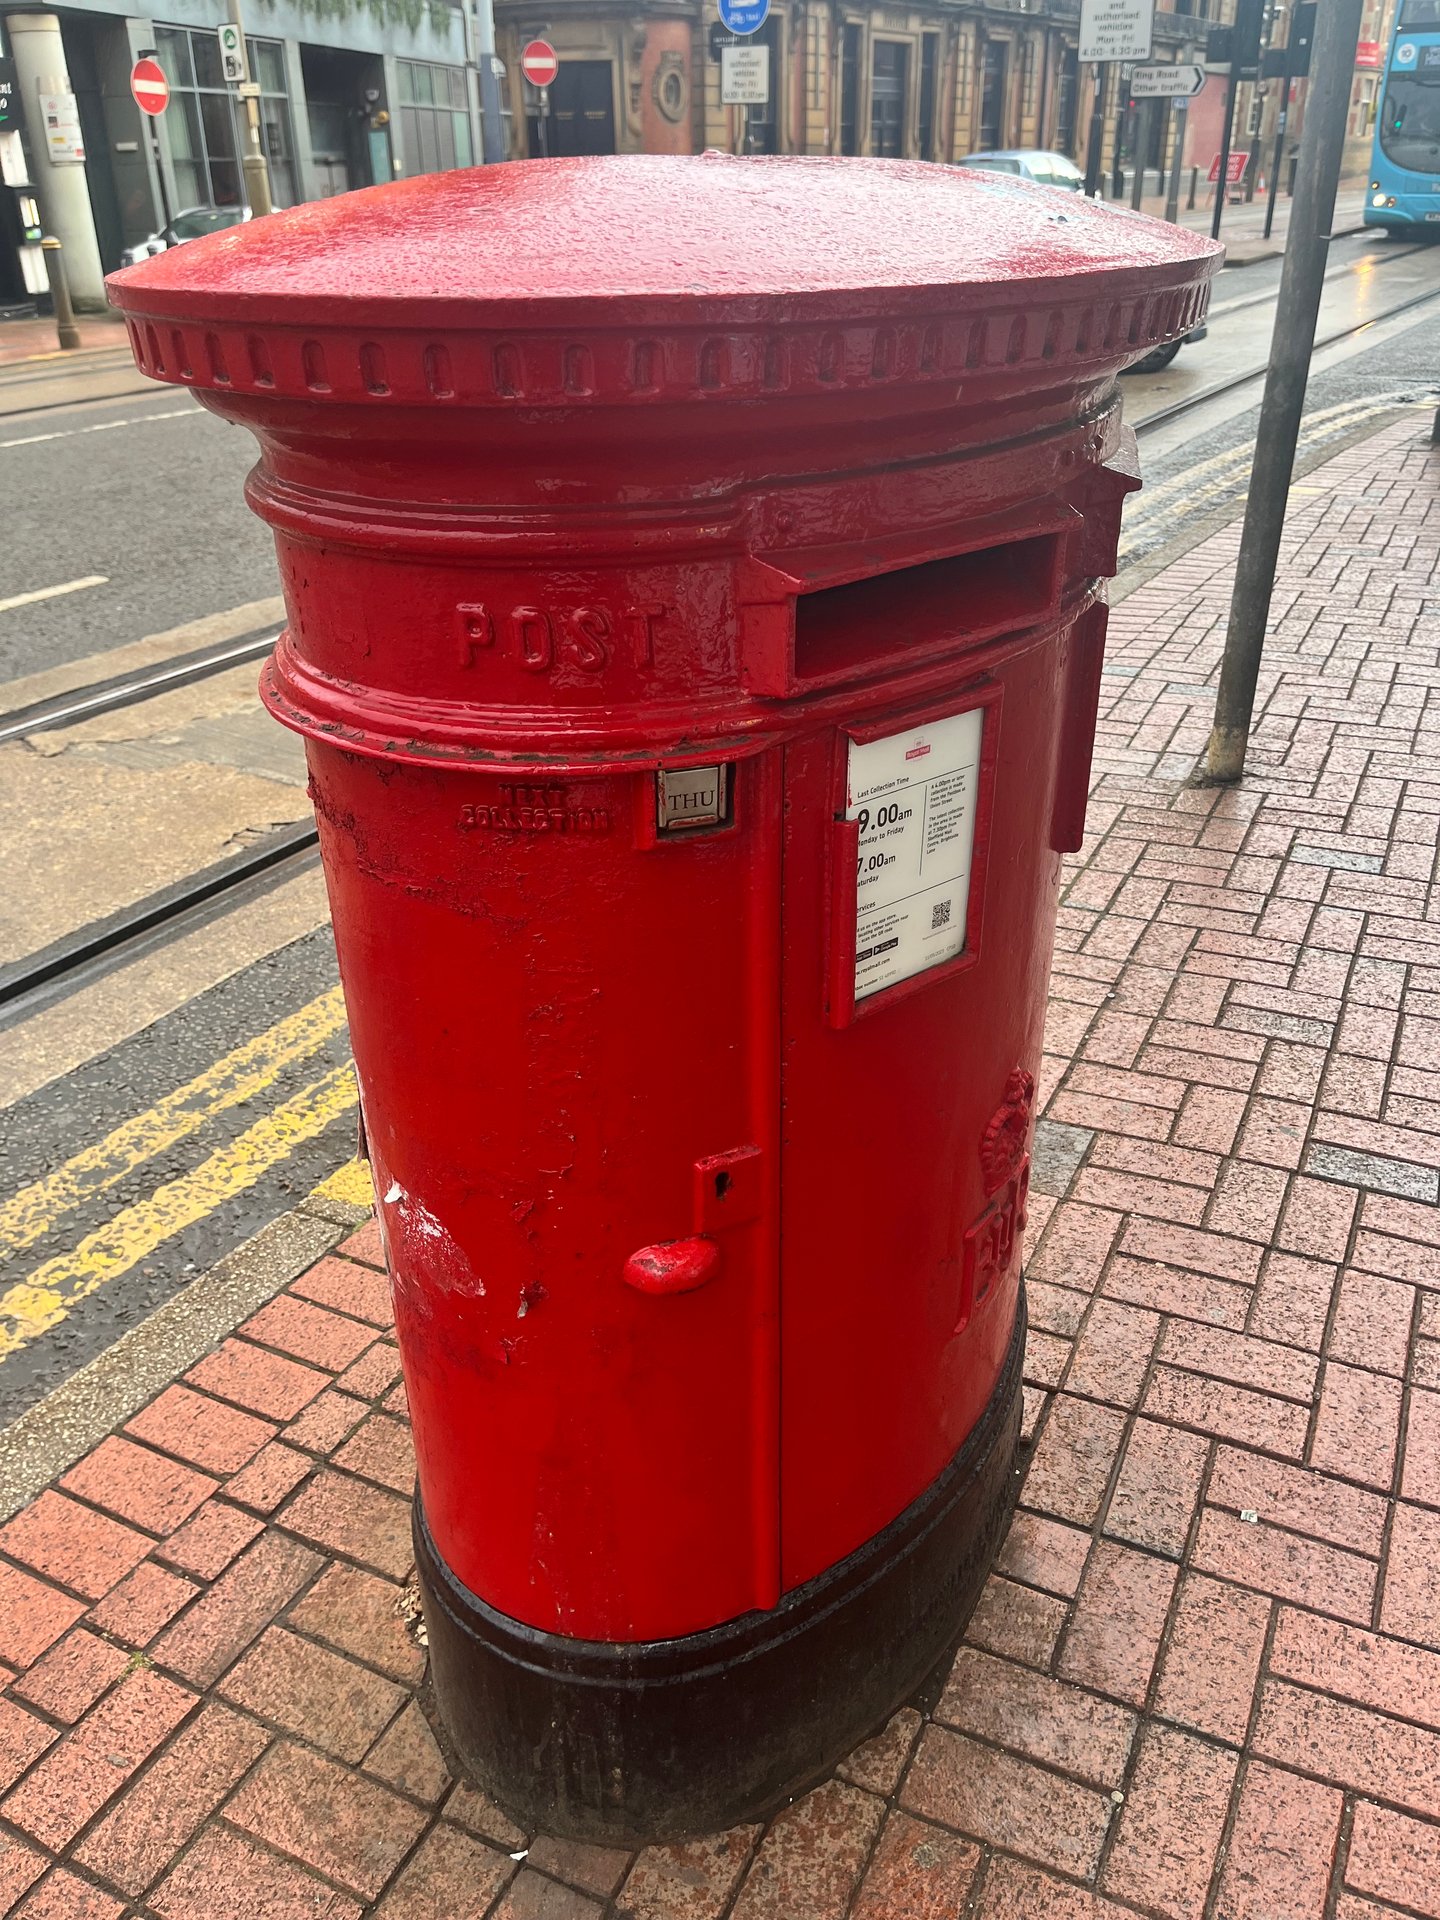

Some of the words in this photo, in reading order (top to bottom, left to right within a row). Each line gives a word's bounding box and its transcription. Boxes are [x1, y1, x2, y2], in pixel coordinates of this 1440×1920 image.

[1135, 71, 1153, 81] Ring
[1157, 70, 1179, 79] Road
[1133, 83, 1157, 92] Other
[1160, 82, 1189, 92] traffic
[456, 602, 663, 671] POST
[857, 789, 869, 799] Last
[870, 781, 896, 795] Collection
[896, 777, 910, 785] Time
[667, 791, 716, 811] THU
[459, 803, 611, 831] COLLECTION
[857, 803, 913, 834] 9.00am
[887, 826, 905, 837] Friday
[857, 875, 880, 888] aturday
[857, 901, 876, 912] ervices
[856, 958, 890, 975] w.royalmail.com
